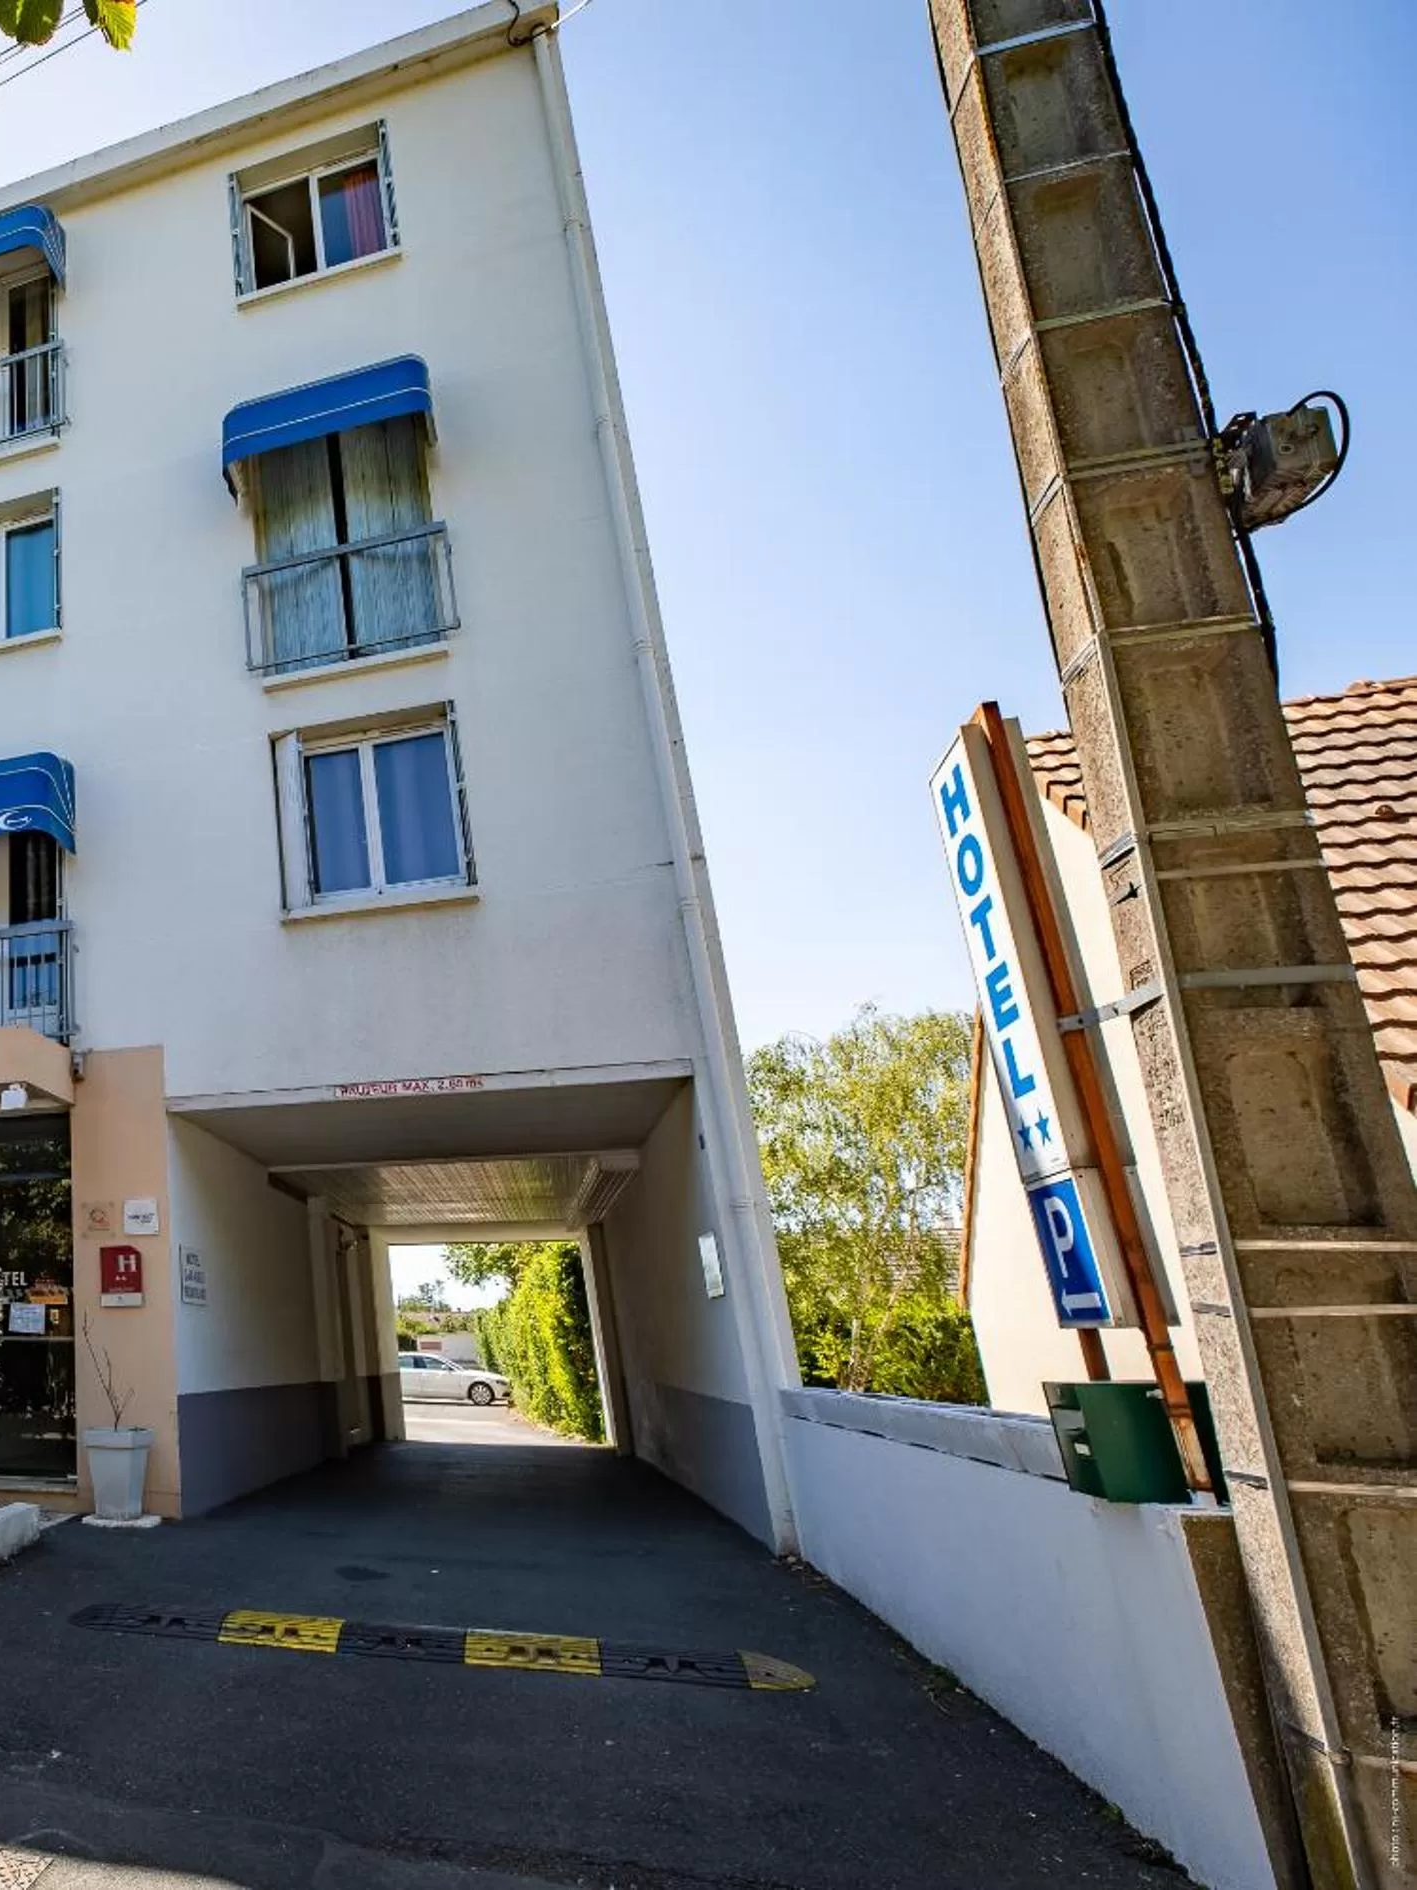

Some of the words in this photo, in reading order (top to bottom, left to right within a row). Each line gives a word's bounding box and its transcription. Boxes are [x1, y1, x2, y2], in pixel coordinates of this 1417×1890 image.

[940, 764, 1036, 1101] HOTEL
[117, 1254, 137, 1273] H
[1043, 1196, 1074, 1279] P
